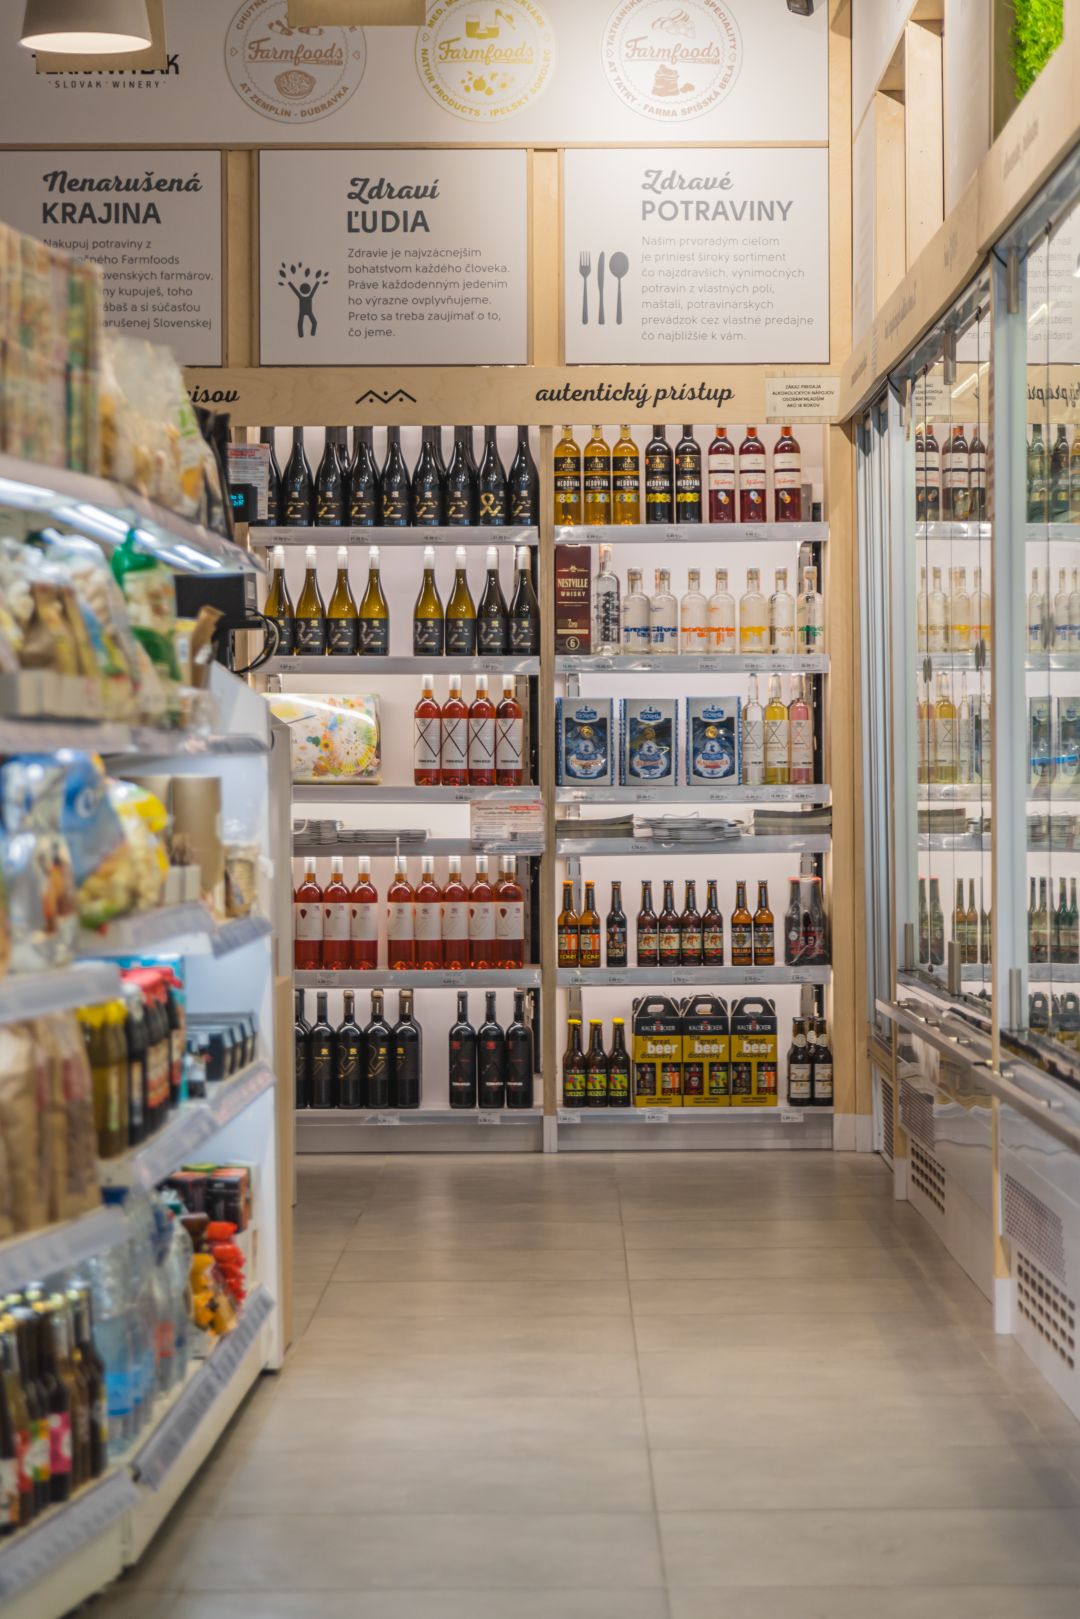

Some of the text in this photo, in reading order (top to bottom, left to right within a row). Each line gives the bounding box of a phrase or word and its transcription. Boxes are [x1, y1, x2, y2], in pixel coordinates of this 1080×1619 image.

[248, 37, 344, 66] Farmfoods
[438, 37, 534, 65] Farmfoods
[625, 36, 720, 65] Farmfoods
[54, 80, 160, 88] SLOVAK WINERY
[432, 84, 481, 117] PRODUCTS
[42, 170, 204, 194] Nenarušená
[641, 169, 734, 195] Zdravé
[346, 177, 440, 205] Zdraví
[42, 202, 162, 224] KRAJINA
[641, 200, 794, 222] POTRAVINY
[346, 210, 430, 233] ĽUDIA
[43, 239, 152, 251] Nakupuj potraviny z
[679, 235, 738, 248] prvoradým
[121, 254, 180, 265] Farmfoods
[348, 247, 388, 258] Zdravie
[391, 247, 401, 260] je
[640, 252, 651, 263] je
[733, 252, 786, 263] sortiment
[348, 263, 510, 274] bohatstvom každého človeka.
[641, 267, 655, 278] čo
[160, 270, 213, 281] farmárov.
[348, 279, 379, 290] Práve
[382, 279, 460, 291] každodenným
[689, 285, 695, 293] z
[698, 283, 749, 296] vlastných
[118, 286, 164, 298] kupuješ,
[167, 287, 193, 297] toho
[131, 303, 138, 312] a
[140, 302, 149, 312] si
[151, 302, 200, 312] súčasťou
[348, 295, 492, 307] ho výrazne ovplyvňujeme.
[348, 311, 379, 321] Preto
[381, 312, 392, 321] sa
[395, 311, 424, 321] treba
[477, 312, 485, 321] o
[487, 311, 501, 322] to,
[641, 315, 815, 328] prevádzok cez vlastné predajne
[153, 317, 212, 330] Slovenskej
[348, 327, 396, 339] čo jeme.
[641, 331, 655, 341] čo
[711, 330, 717, 341] k
[720, 331, 747, 341] vám.
[535, 381, 736, 409] autentický prístup
[558, 578, 588, 588] NESTVILLE
[570, 638, 576, 648] 6
[647, 1041, 678, 1054] beer
[694, 1041, 726, 1054] beer
[742, 1040, 774, 1054] beer
